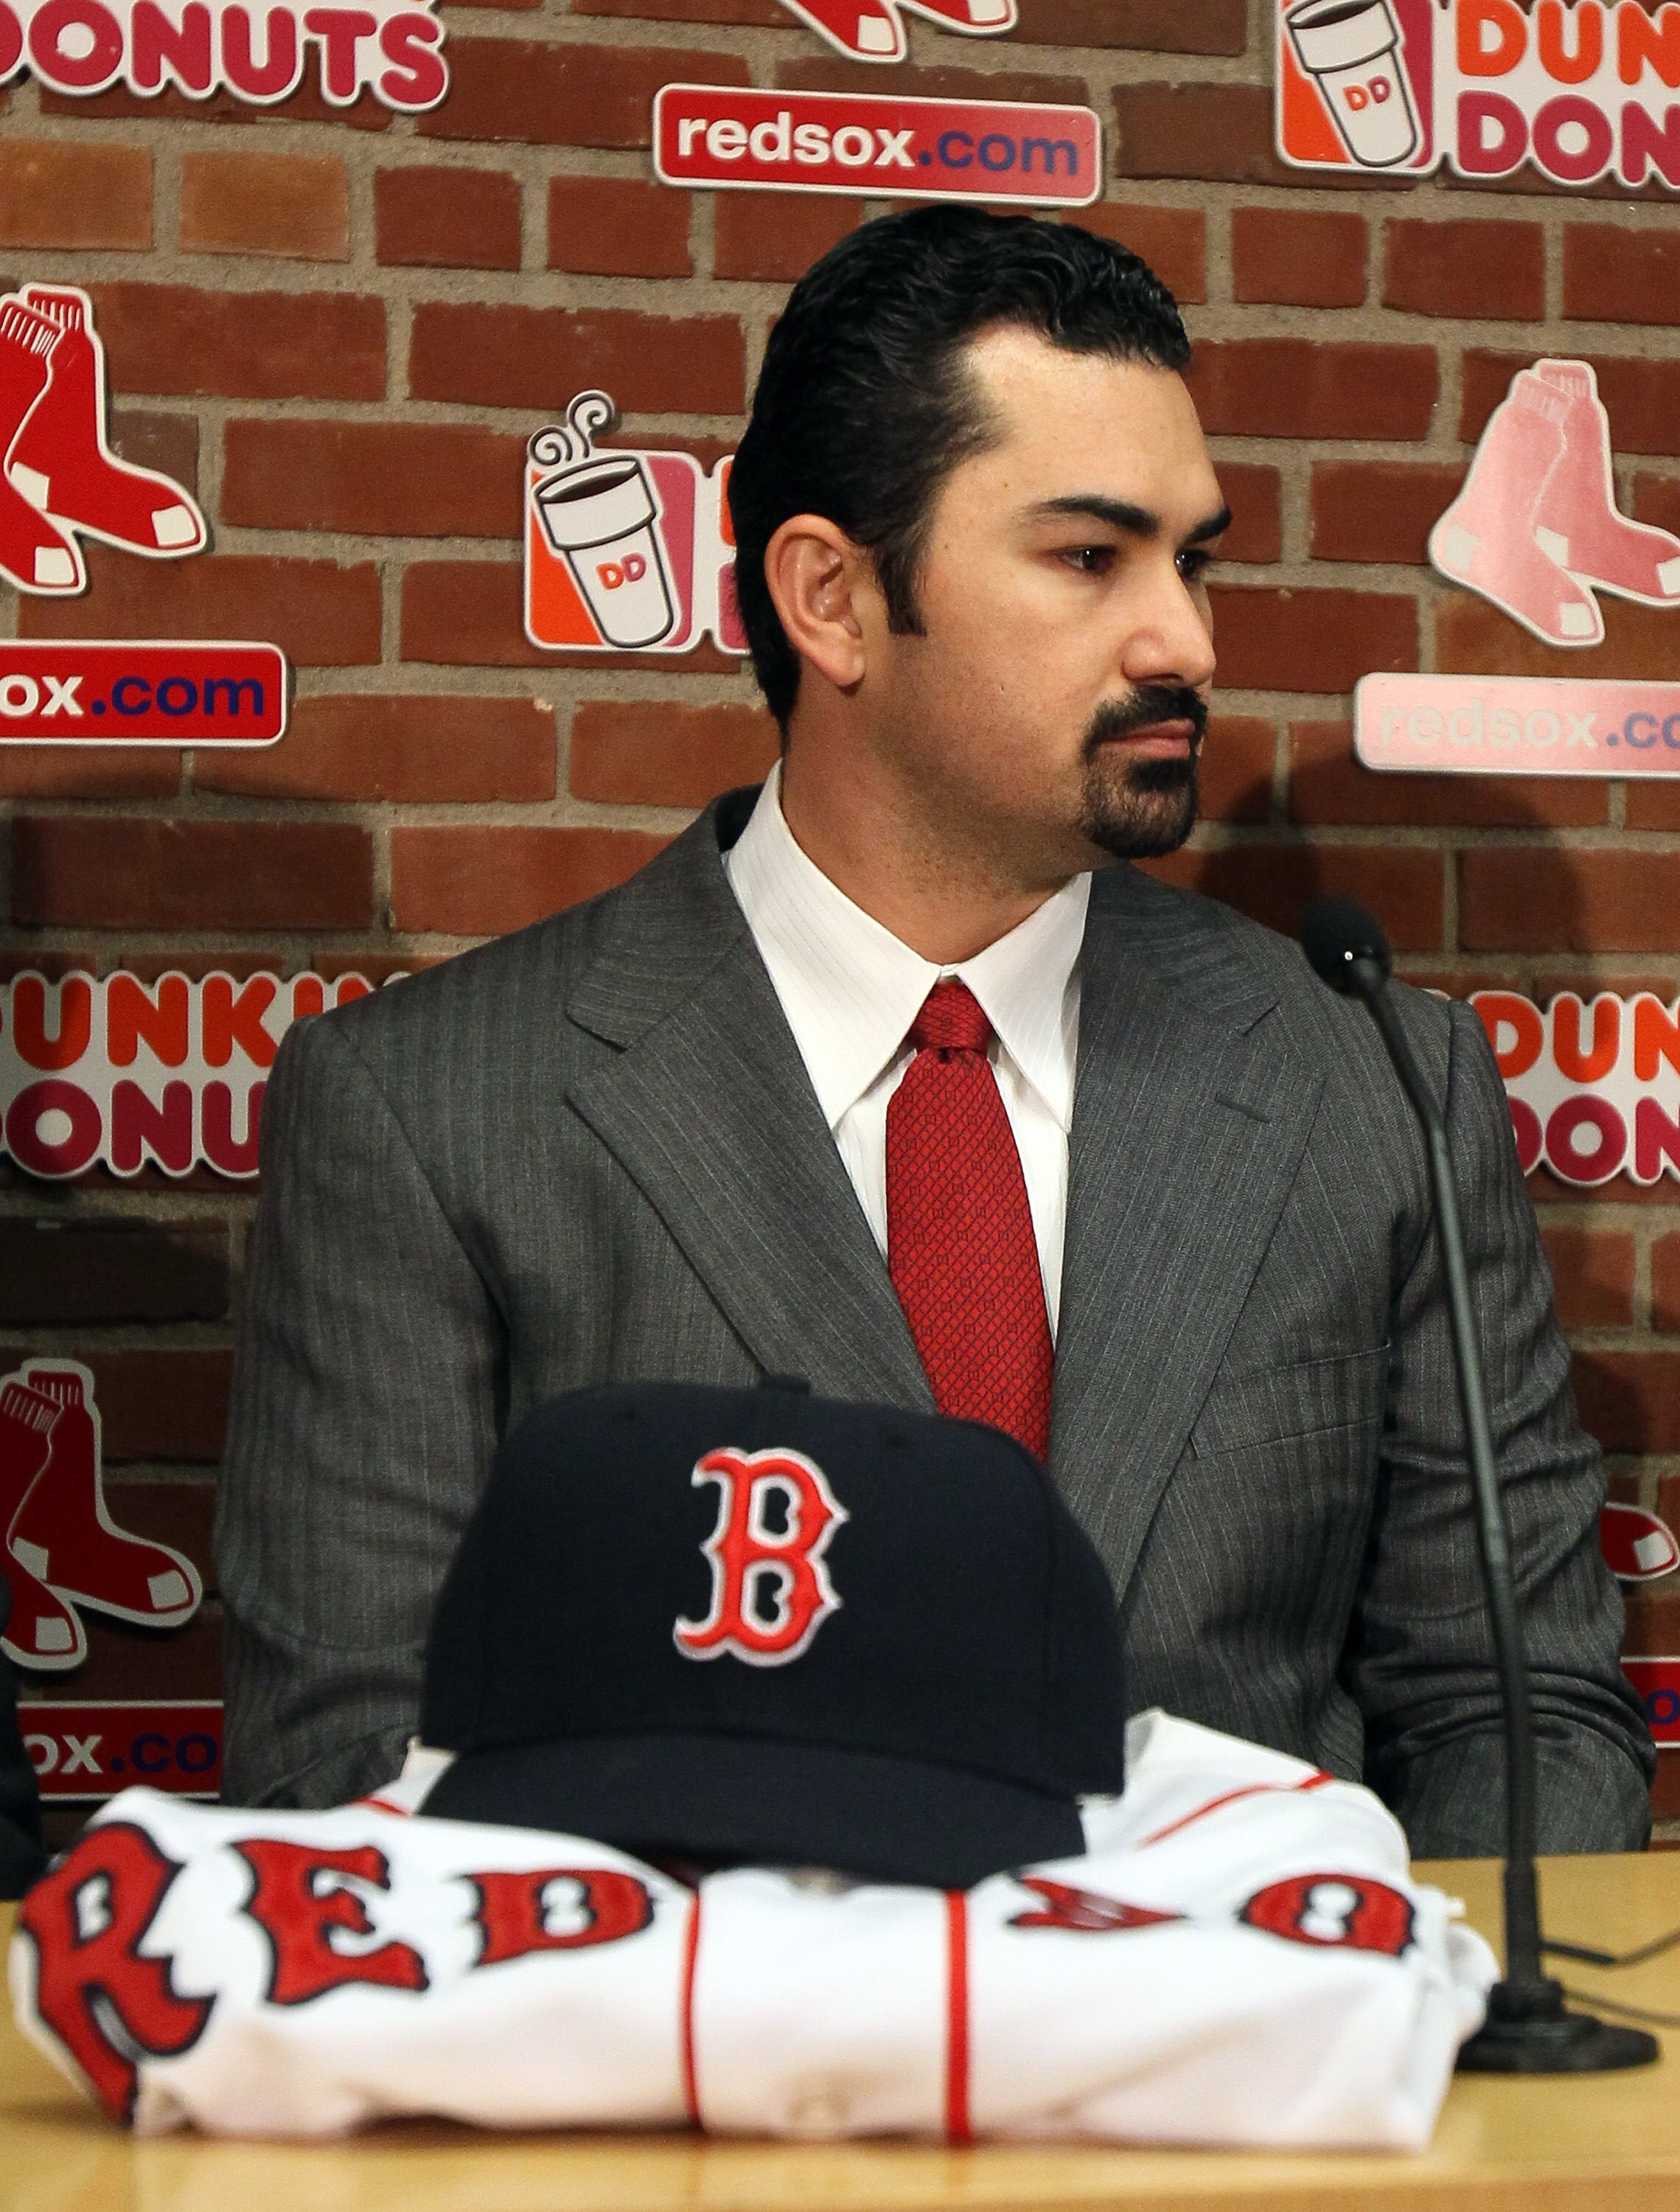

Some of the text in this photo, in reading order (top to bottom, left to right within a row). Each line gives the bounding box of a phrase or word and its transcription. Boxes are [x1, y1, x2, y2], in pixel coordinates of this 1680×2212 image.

[677, 111, 1078, 175] redsox.com
[0, 1079, 267, 1173] ONU
[673, 1447, 851, 1668] B
[20, 1821, 658, 2126] RED
